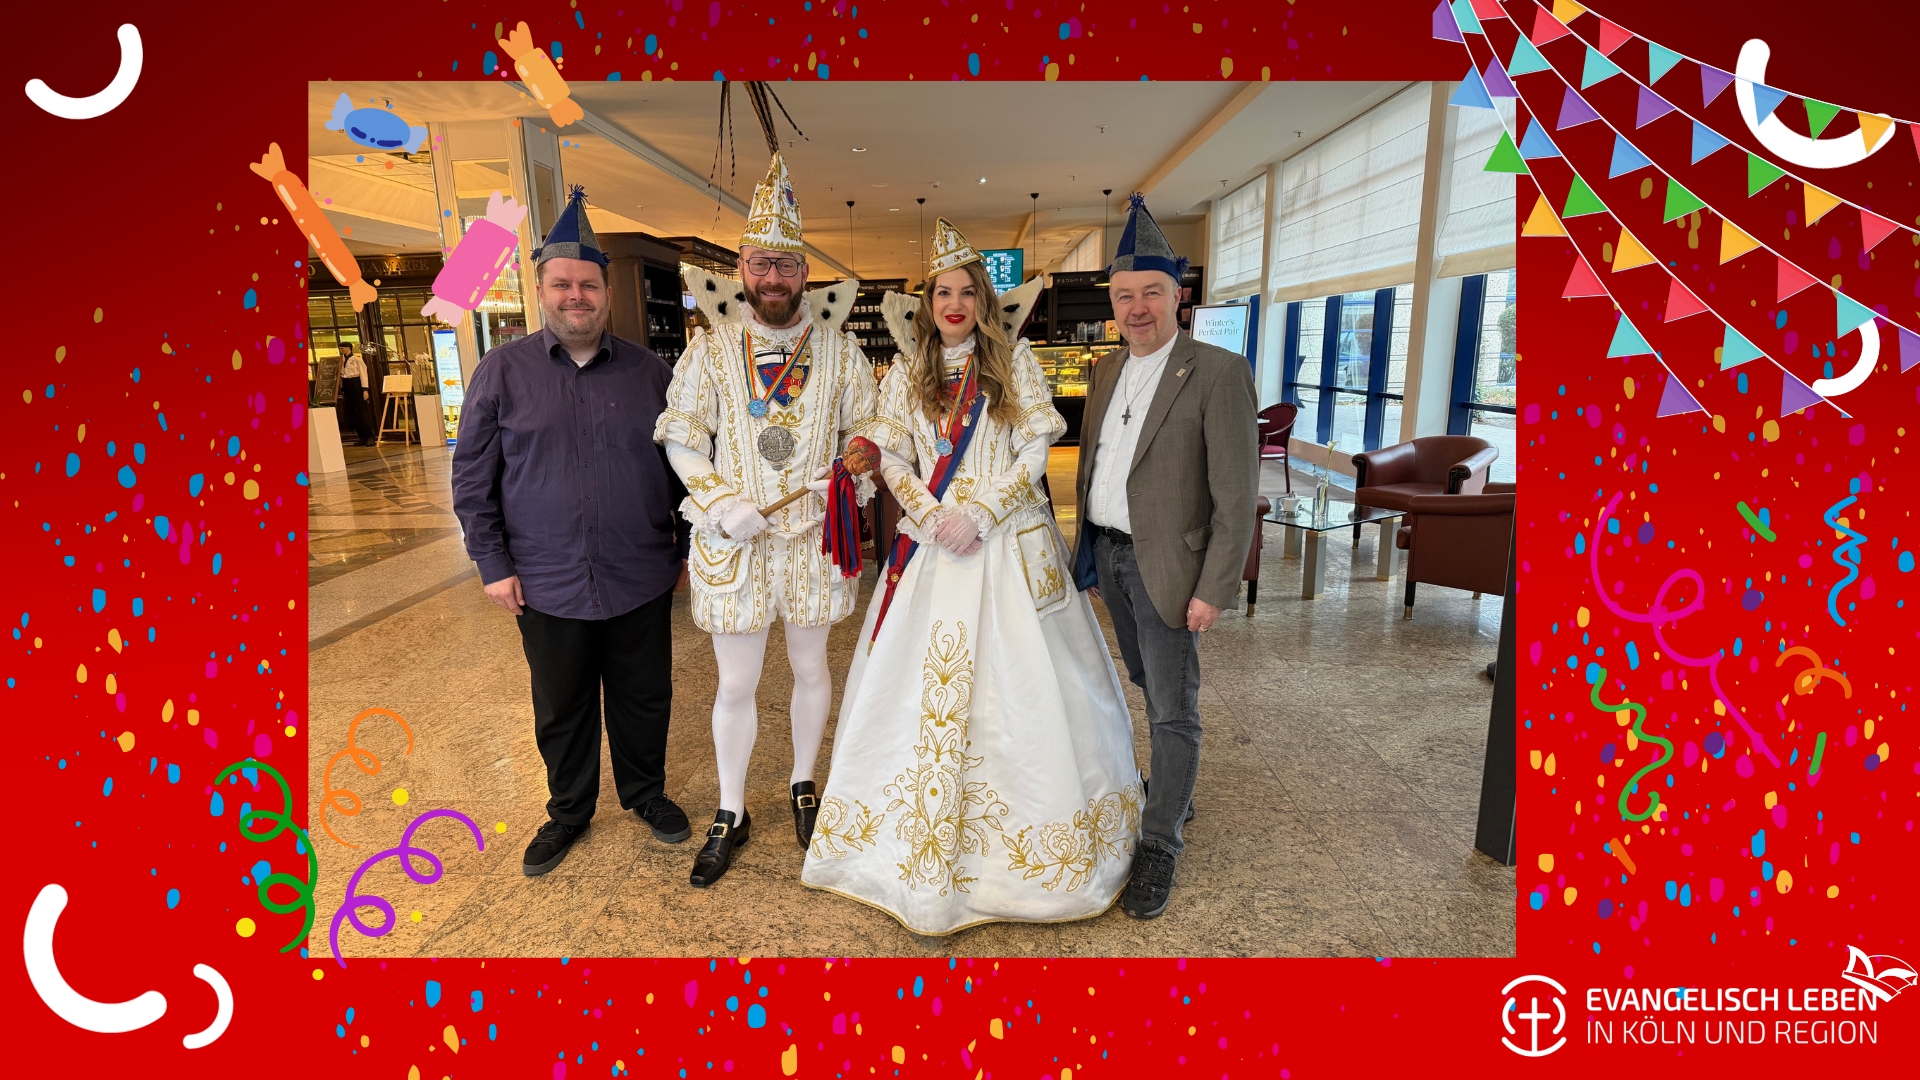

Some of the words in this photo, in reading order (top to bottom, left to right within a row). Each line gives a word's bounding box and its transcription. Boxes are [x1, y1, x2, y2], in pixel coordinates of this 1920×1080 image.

[1205, 318, 1235, 327] Winter's
[1198, 327, 1222, 336] Perfect
[1224, 327, 1240, 335] Pair
